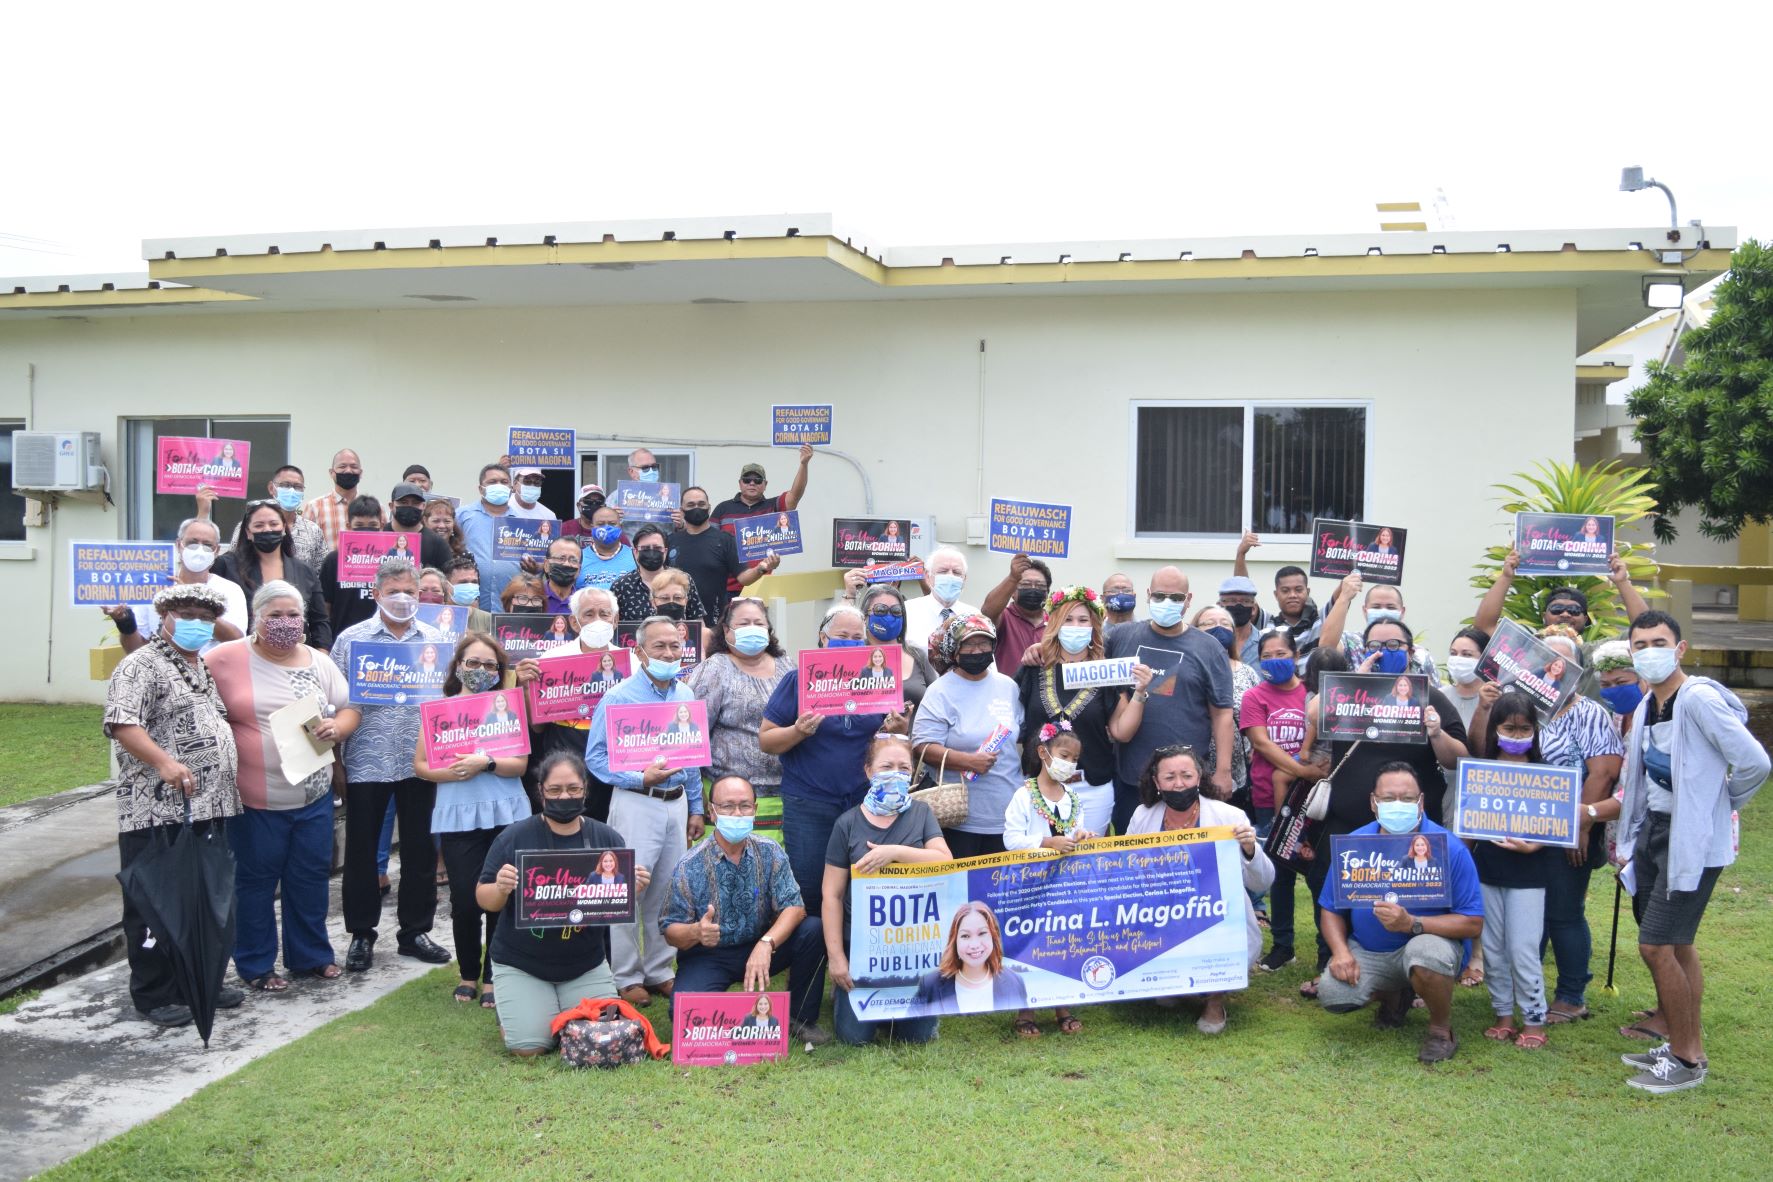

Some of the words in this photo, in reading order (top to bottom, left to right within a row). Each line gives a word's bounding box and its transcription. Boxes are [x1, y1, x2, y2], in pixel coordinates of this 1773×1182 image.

[512, 431, 571, 440] REFALUWASCH
[775, 432, 798, 442] CORINA
[511, 456, 536, 465] CORINA
[203, 464, 242, 477] CORINA
[995, 503, 1066, 519] REFALUWASCH
[1006, 516, 1023, 524] GOOD
[1025, 519, 1066, 528] GOVERNANCE
[1003, 525, 1034, 537] BOTA
[1044, 530, 1055, 539] SI
[872, 542, 905, 551] CORINA
[992, 534, 1020, 551] CORINA
[1565, 541, 1606, 553] CORINA
[78, 549, 168, 561] REFALUWASCH
[1359, 551, 1398, 565] CORINA
[79, 562, 93, 570] FOR
[119, 563, 168, 571] GOVERNANCE
[91, 573, 133, 583] BOTA
[143, 574, 157, 583] SI
[78, 585, 116, 600] CORINA
[852, 676, 895, 690] CORINA
[1515, 680, 1535, 695] WOMEN
[1519, 669, 1560, 702] CORINA
[1374, 705, 1420, 719] CORINA
[479, 719, 520, 737] CORINA
[660, 731, 702, 745] CORINA
[1467, 769, 1570, 790] REFALUWASCH
[1467, 784, 1482, 794] FOR
[1486, 785, 1511, 796] GOOD
[1513, 788, 1569, 802] GOVERNANCE
[1480, 797, 1528, 813] BOTA
[1539, 802, 1555, 815] SI
[1464, 810, 1507, 832] CORINA
[1511, 814, 1568, 837] MAGOFNA
[910, 866, 938, 874] ASKING
[978, 856, 1001, 864] VOTES
[1027, 851, 1059, 859] SPECIAL
[1114, 837, 1153, 847] PRECINCT
[1340, 850, 1368, 869] For
[1370, 852, 1398, 874] You
[1020, 867, 1048, 881] Ready
[1059, 860, 1091, 874] Restore
[1096, 857, 1122, 871] Fiscal
[1127, 850, 1189, 868] Responsibility
[526, 867, 552, 887] For
[556, 868, 585, 887] You
[535, 885, 566, 899] BOTA!
[578, 883, 627, 898] CORINA
[870, 892, 940, 926] BOTA
[1005, 910, 1083, 936] Corina
[1090, 907, 1109, 927] L.
[1116, 895, 1228, 927] Magofña
[870, 928, 879, 944] SI
[884, 923, 940, 944] CORINA
[869, 952, 943, 972] PUBLIKU
[683, 1009, 706, 1028] For
[713, 1010, 739, 1030] You
[692, 1026, 722, 1040] BOTA!
[733, 1026, 781, 1039] CORINA
